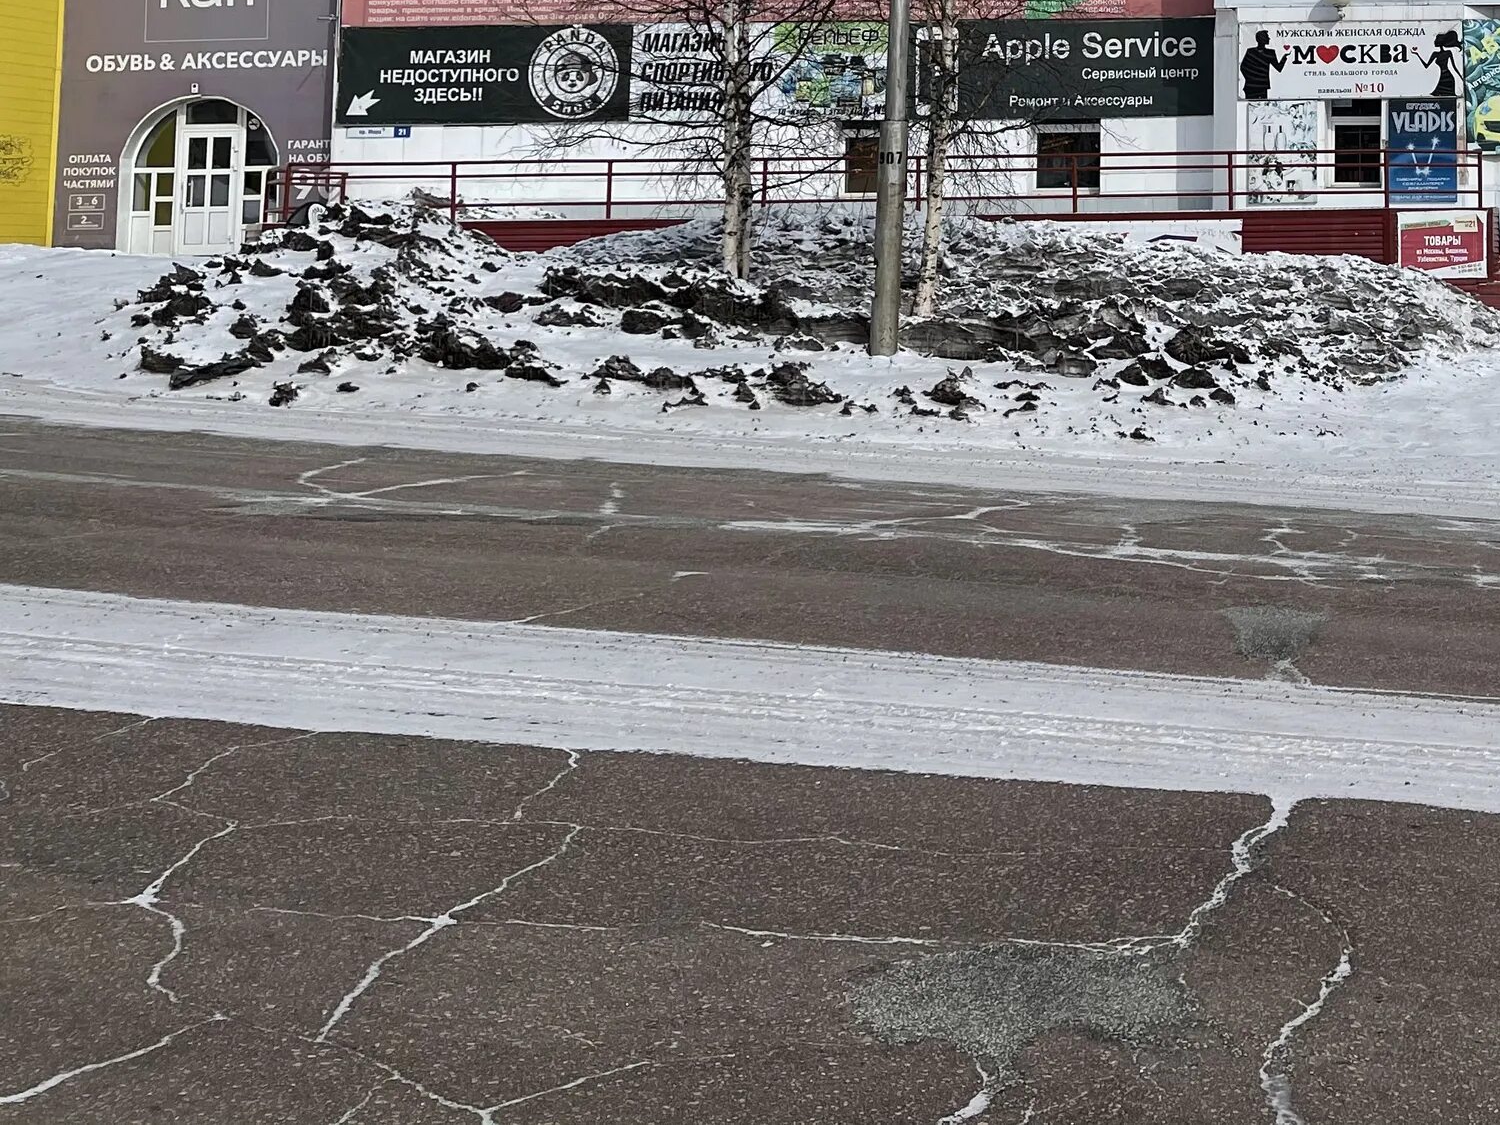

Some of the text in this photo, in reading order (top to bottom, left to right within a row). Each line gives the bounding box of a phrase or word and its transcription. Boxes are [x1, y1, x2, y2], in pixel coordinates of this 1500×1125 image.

[1276, 29, 1324, 38] МУЖСКАЯ
[1335, 29, 1382, 37] ЖЕНСКАЯ
[1385, 28, 1426, 38] ОДЕЖДА
[543, 30, 606, 53] PANDA
[982, 31, 1197, 65] Apple Service
[86, 49, 328, 73] ОБУВЬ & АКСЕССУАРЫ
[409, 49, 491, 65] МАГАЗИН
[380, 68, 520, 85] НЕДОСТУПНОГО
[1082, 66, 1199, 81] Сервисный центр
[1355, 82, 1385, 94] №10
[414, 87, 483, 104] ЗДЕСЬ!!
[1009, 95, 1058, 107] Ремонт
[1074, 94, 1153, 108] Аксессуары
[1392, 111, 1455, 134] VLADIS
[68, 154, 112, 164] ОПЛАТА
[289, 154, 304, 163] НА
[63, 166, 116, 176] ПОКУПОК
[63, 178, 115, 189] ЧАСТЯМИ
[1424, 235, 1461, 246] ТОВАРЫ
